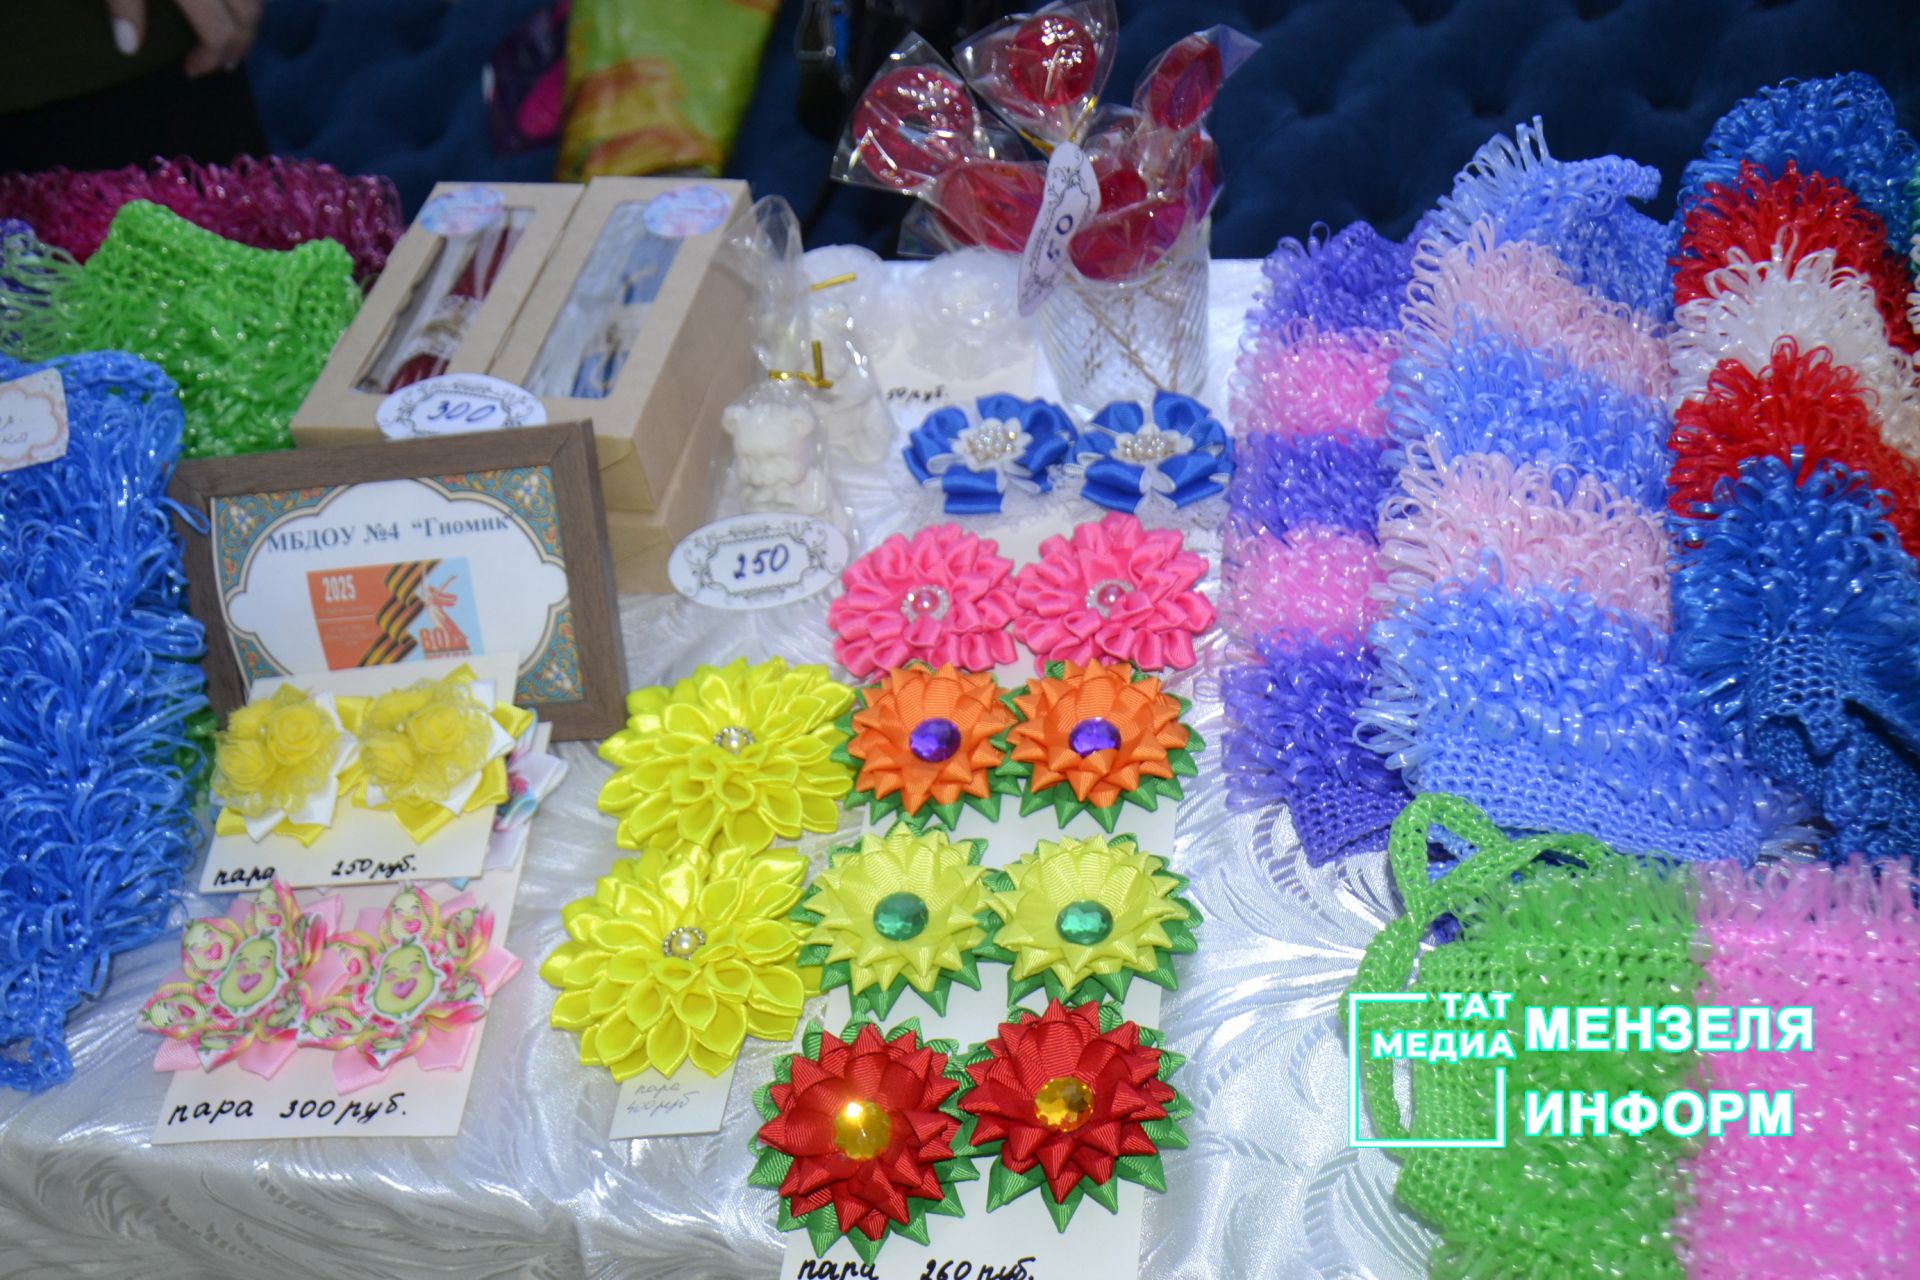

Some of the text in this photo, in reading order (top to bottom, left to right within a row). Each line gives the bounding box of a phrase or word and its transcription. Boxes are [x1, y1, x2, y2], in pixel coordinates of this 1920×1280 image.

[427, 400, 496, 422] 300
[267, 525, 356, 553] МБДОУ
[363, 521, 399, 543] №4
[322, 574, 357, 602] 2025
[213, 866, 277, 887] пара
[167, 1099, 254, 1125] пара
